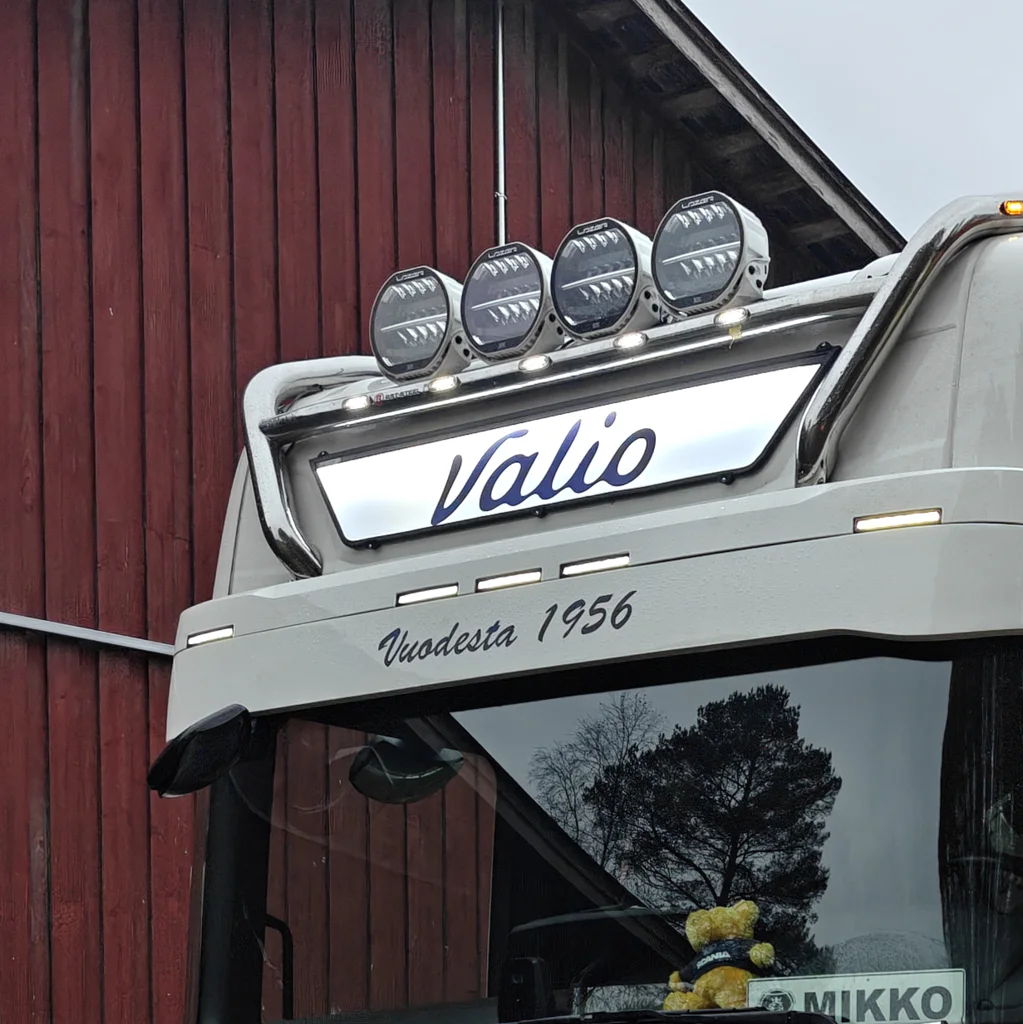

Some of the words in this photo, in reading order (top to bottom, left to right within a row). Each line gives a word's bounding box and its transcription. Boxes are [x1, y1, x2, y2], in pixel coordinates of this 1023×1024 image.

[431, 411, 656, 526] Valio
[378, 620, 518, 667] Vuodesta
[537, 591, 637, 643] 1956
[804, 986, 952, 1023] MIKKO
